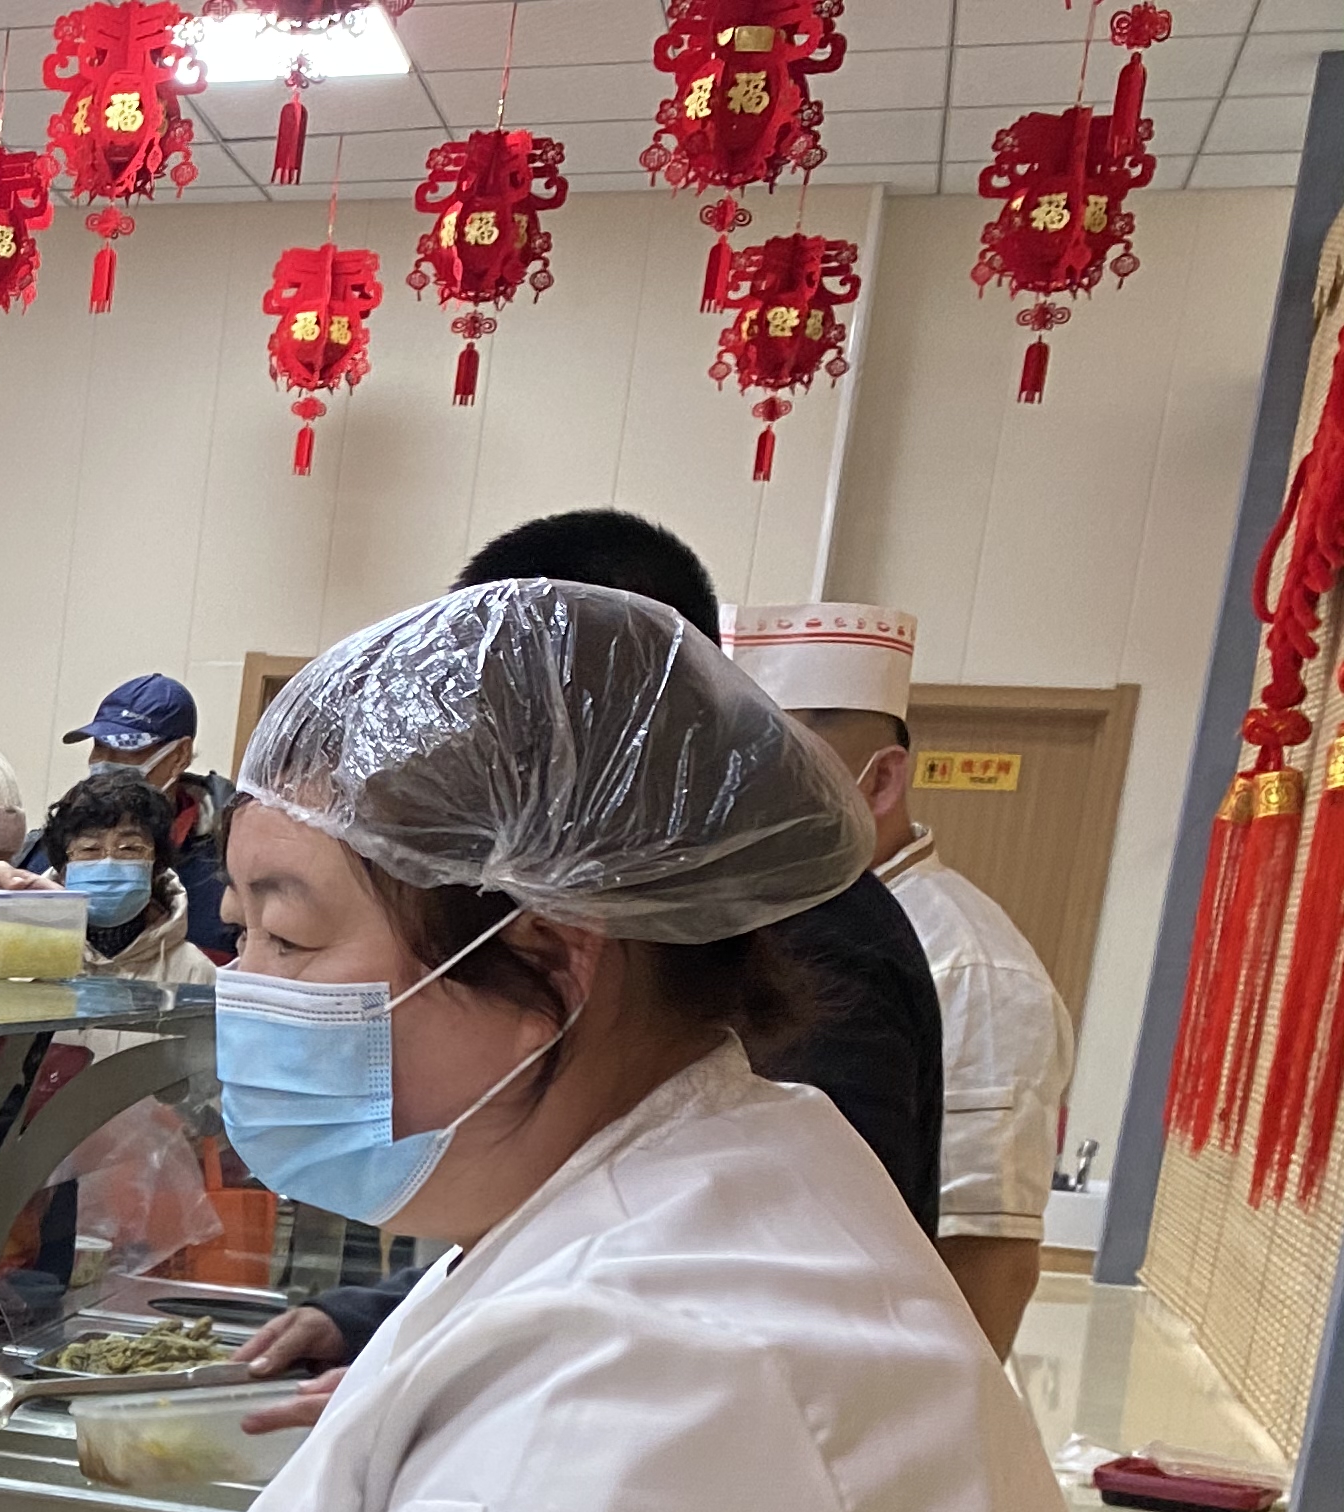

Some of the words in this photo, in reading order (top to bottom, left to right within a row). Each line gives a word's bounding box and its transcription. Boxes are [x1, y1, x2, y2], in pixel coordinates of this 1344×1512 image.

[105, 92, 144, 132] 福
[728, 71, 770, 115] 福
[465, 211, 500, 246] 福
[1030, 192, 1071, 232] 福
[290, 311, 321, 341] 福
